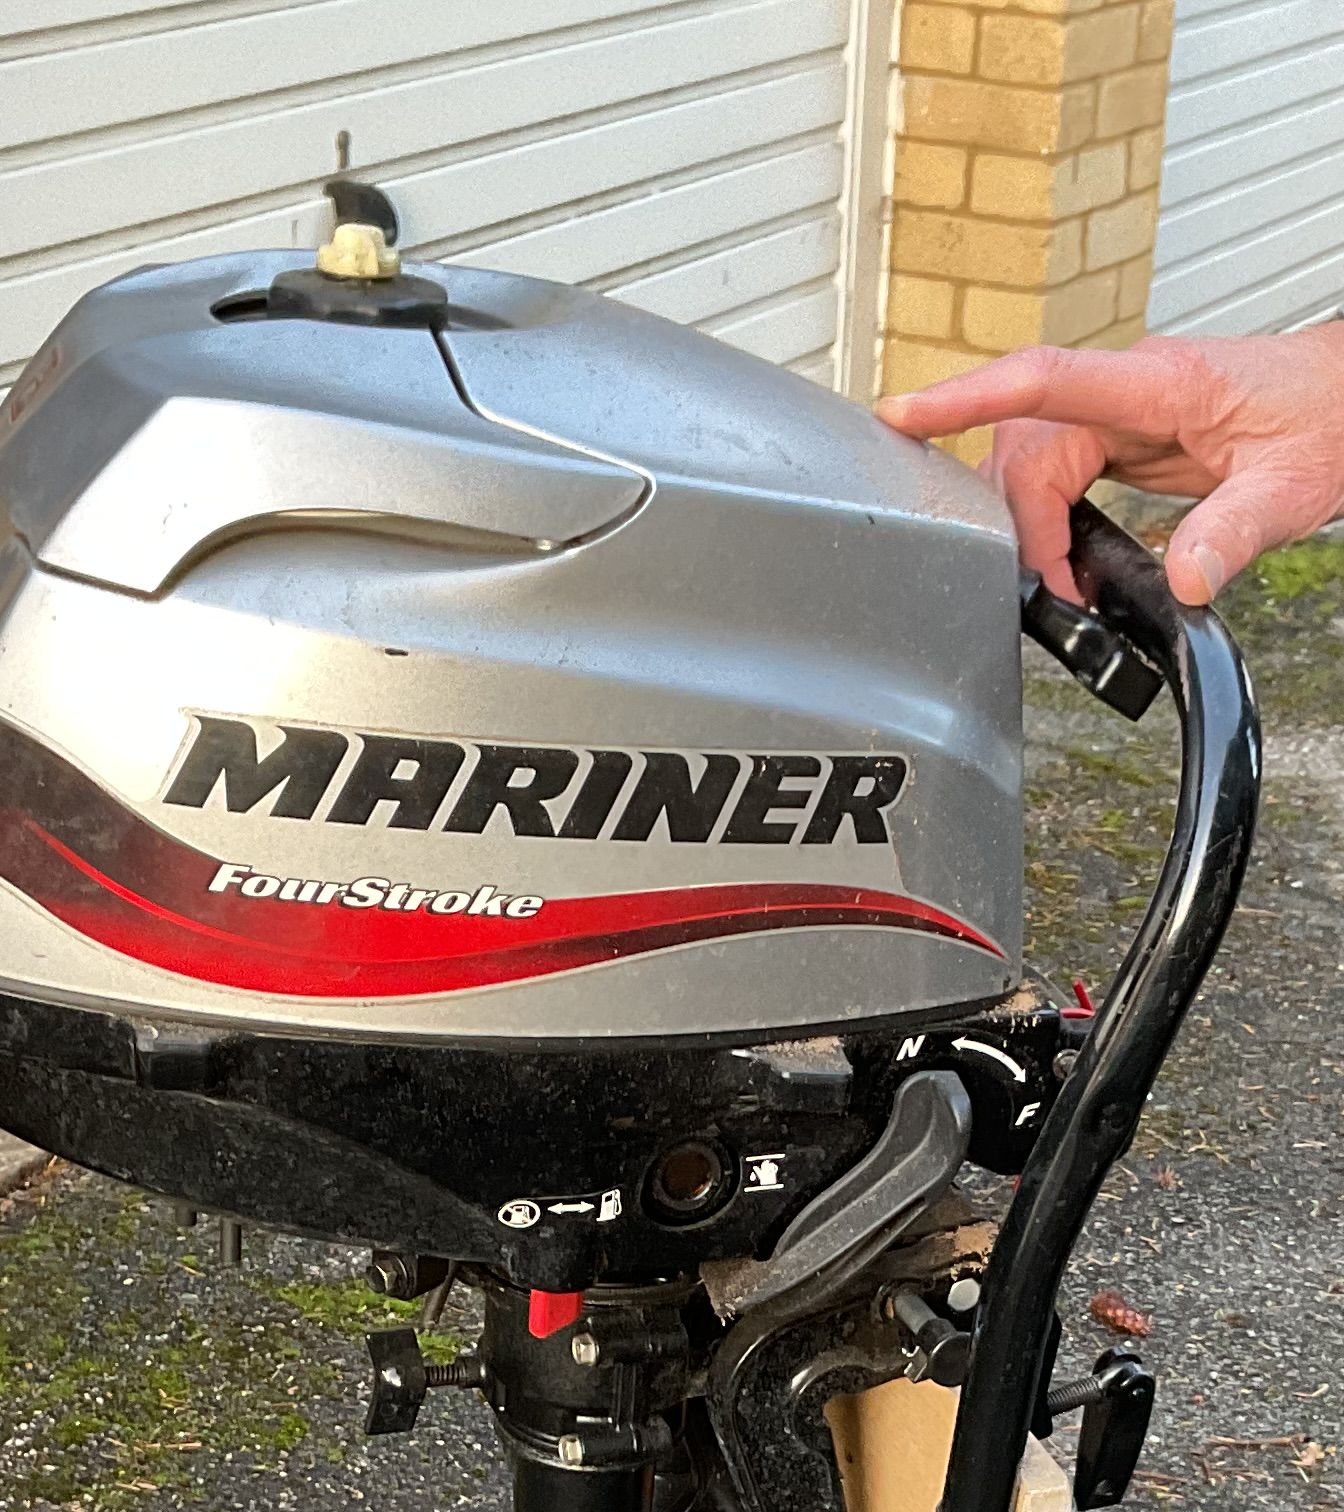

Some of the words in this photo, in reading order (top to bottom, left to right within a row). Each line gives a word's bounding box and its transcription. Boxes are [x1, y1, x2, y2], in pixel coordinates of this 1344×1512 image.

[162, 714, 908, 846] MARINER
[208, 862, 544, 920] FourStroke
[896, 1034, 926, 1061] N
[1014, 1101, 1041, 1126] F
